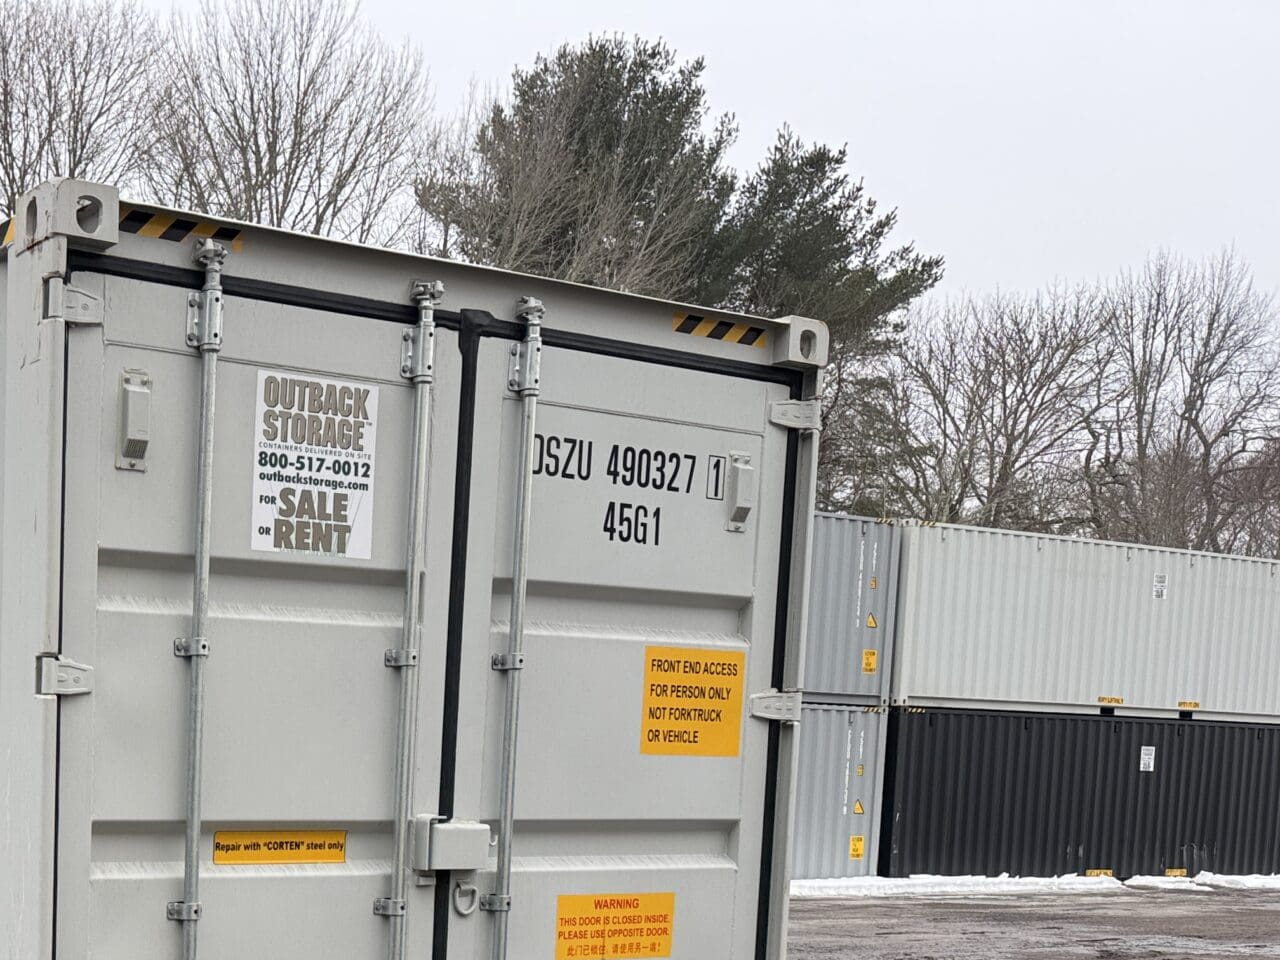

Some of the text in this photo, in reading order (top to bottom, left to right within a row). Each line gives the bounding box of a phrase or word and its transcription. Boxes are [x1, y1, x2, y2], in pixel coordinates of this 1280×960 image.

[263, 375, 370, 420] OUTBACK
[263, 409, 365, 451] STORAGE
[258, 442, 302, 453] CONTAINERS
[305, 447, 342, 457] DELIVERED
[258, 451, 371, 478] 800-517-0012
[532, 433, 593, 481] DSZU
[606, 444, 697, 494] 490327
[259, 470, 369, 491] outbackstorage.com
[259, 487, 349, 523] FOR SALE
[603, 501, 661, 546] 45G1
[258, 518, 352, 554] OR RENT
[651, 658, 738, 676] FRONT END ACCESS
[650, 683, 732, 700] FOR PERSON ONLY
[648, 706, 722, 722] NOT FORKTRUCK
[647, 729, 699, 743] OR VEHICLE
[215, 841, 344, 853] Repair with "CORTEN" steel only
[594, 898, 640, 910] WARNING
[559, 917, 577, 927] THIS
[579, 916, 601, 926] DOOR
[603, 916, 610, 925] IS
[612, 915, 642, 925] CLOSED
[558, 930, 588, 940] PLEASE
[590, 929, 605, 939] USE
[607, 928, 644, 938] OPPOSITE
